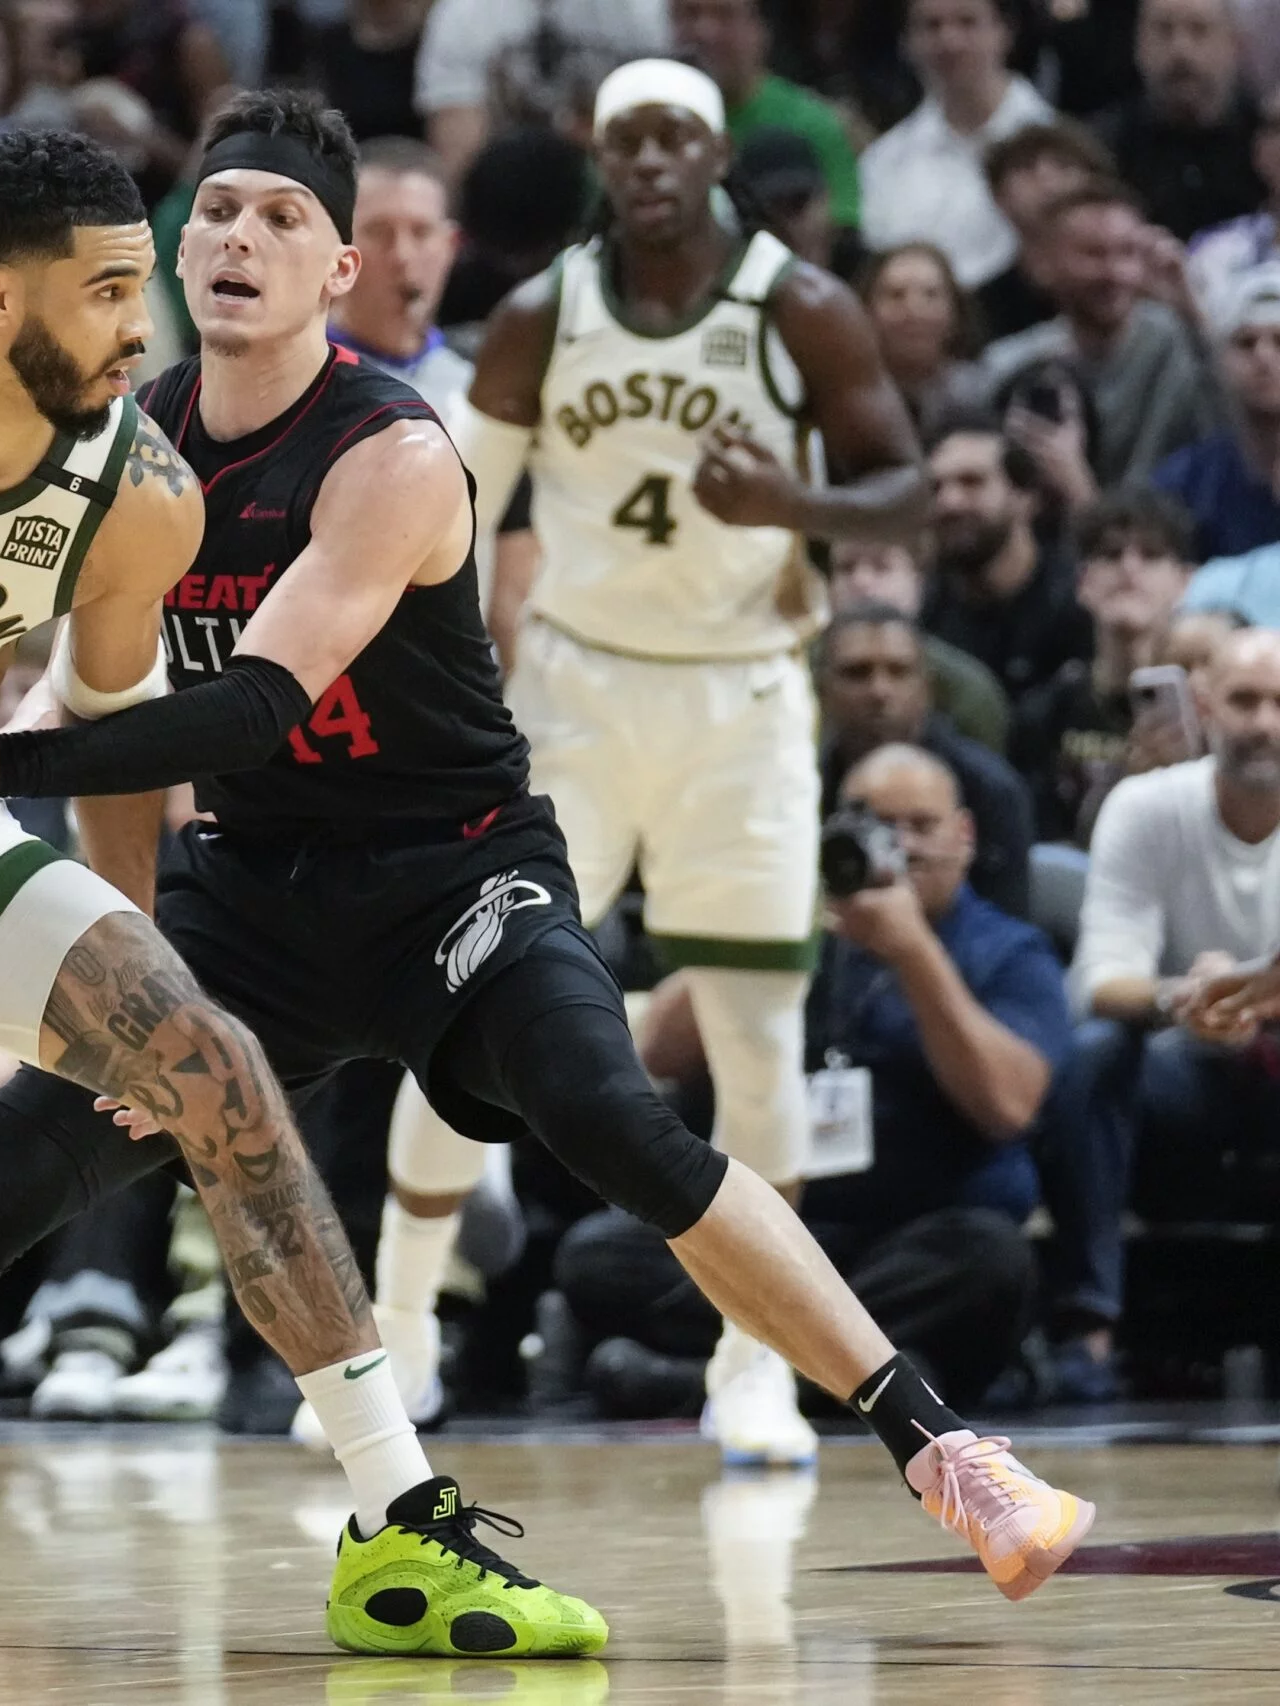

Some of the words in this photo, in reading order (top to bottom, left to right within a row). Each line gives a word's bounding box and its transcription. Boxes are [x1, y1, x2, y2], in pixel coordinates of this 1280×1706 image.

[555, 370, 752, 449] BOSTO
[69, 476, 83, 492] 6
[612, 472, 677, 546] 4
[15, 520, 64, 551] VISTA
[3, 541, 58, 567] PRINT
